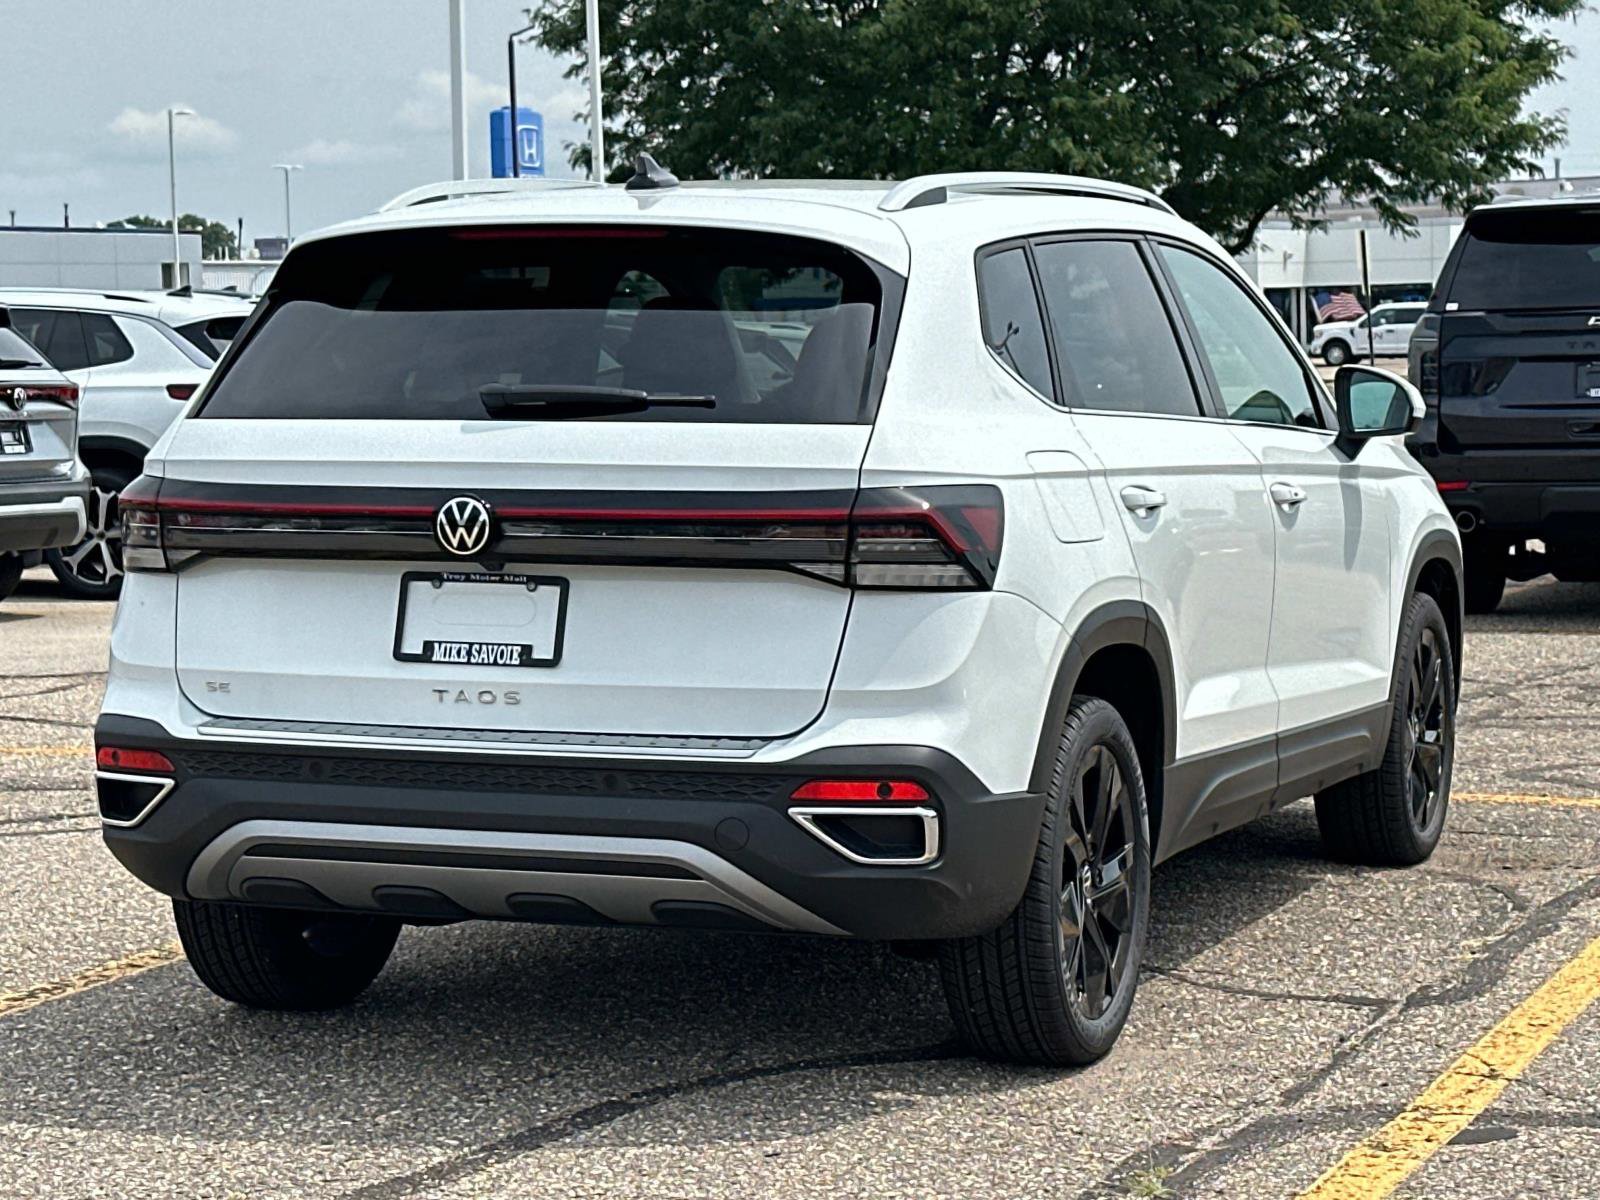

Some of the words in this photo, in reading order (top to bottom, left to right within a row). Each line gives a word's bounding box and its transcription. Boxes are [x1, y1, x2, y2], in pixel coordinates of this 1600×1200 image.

[439, 498, 487, 551] VW
[443, 572, 466, 582] Troy
[470, 573, 501, 581] Motor
[432, 642, 469, 662] MIKE
[471, 644, 522, 665] SAVOIE
[206, 681, 231, 694] SE
[432, 688, 521, 705] TAOS
